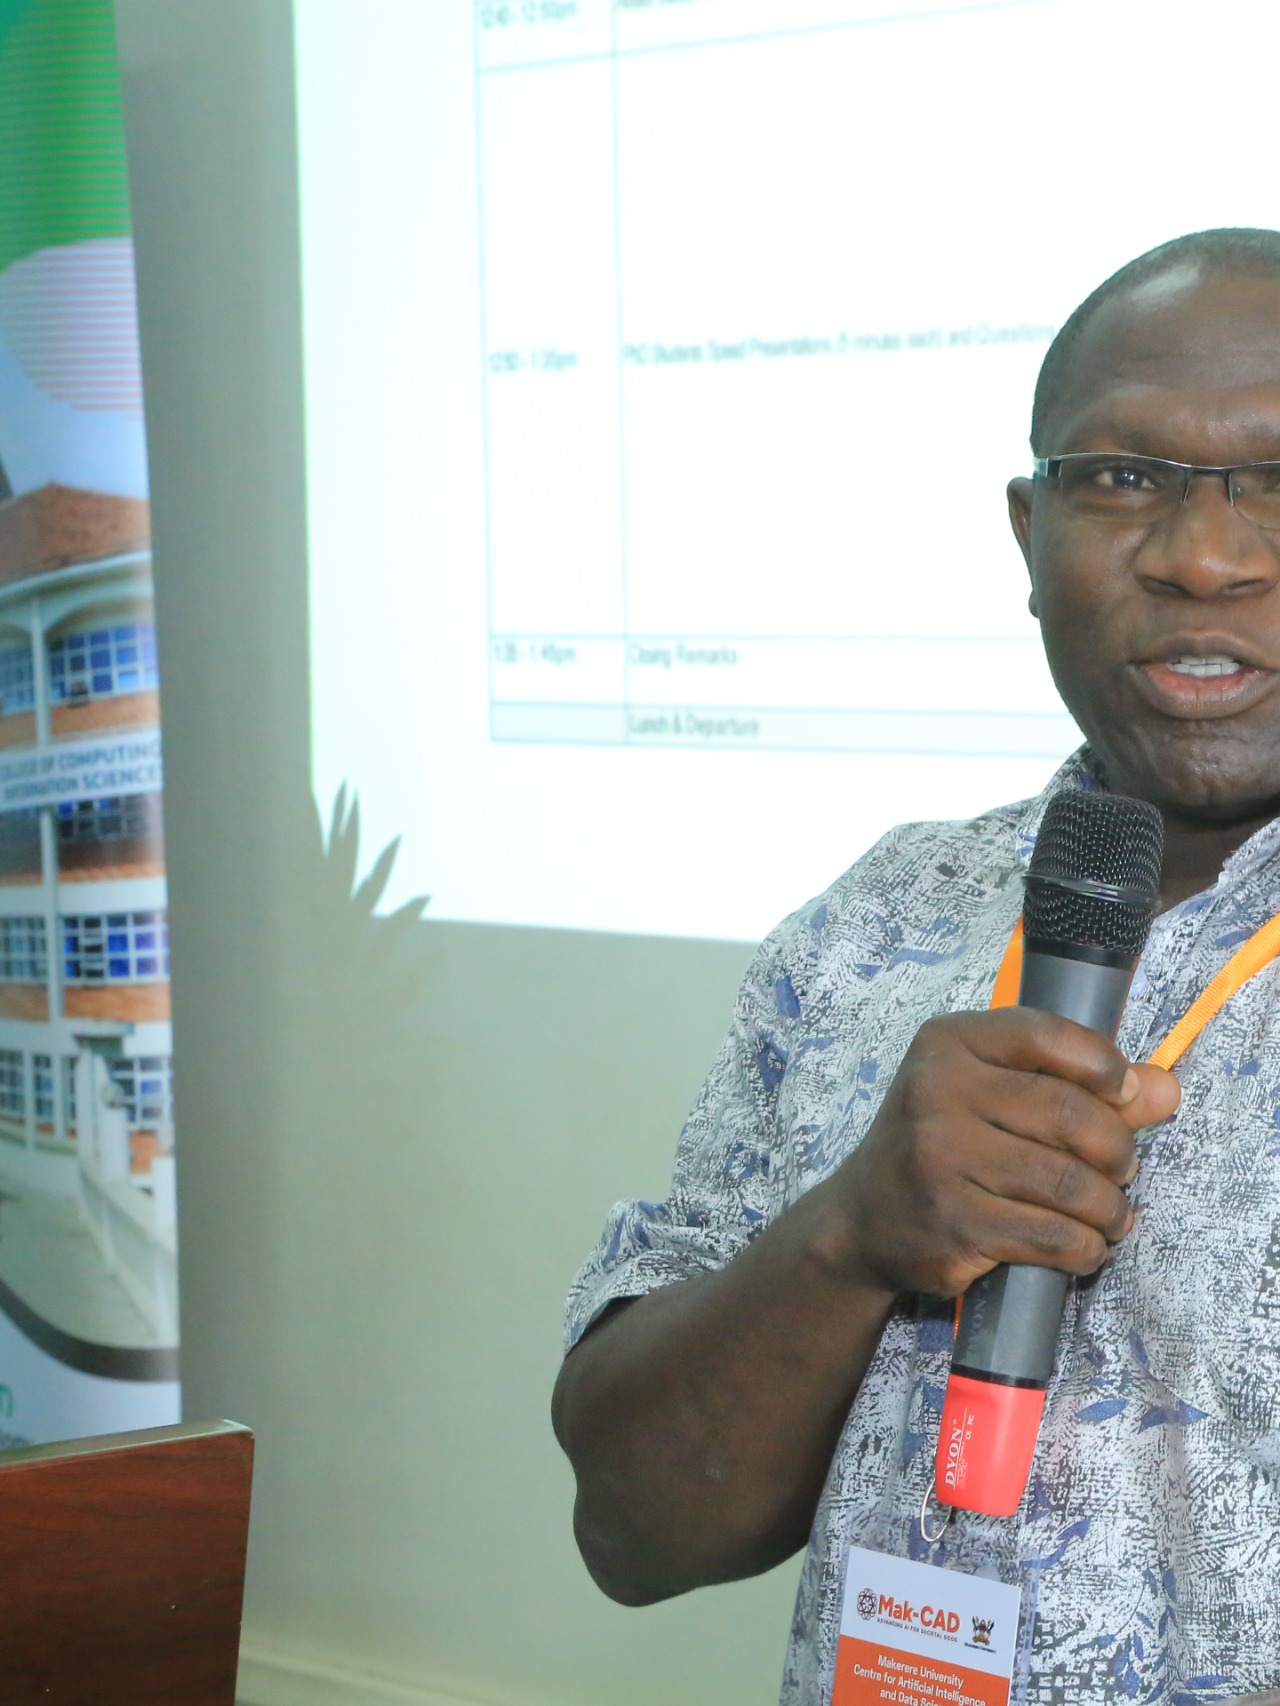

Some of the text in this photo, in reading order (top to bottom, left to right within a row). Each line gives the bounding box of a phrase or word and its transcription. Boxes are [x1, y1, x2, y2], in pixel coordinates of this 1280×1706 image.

[949, 325, 972, 347] and
[676, 643, 739, 666] Remarks
[628, 712, 760, 742] Lunch & Departure
[878, 1594, 960, 1634] Mak-CAD
[877, 1617, 903, 1629] ADVANCING
[921, 1628, 943, 1640] SOCIETAL
[853, 1663, 986, 1706] Centre for Artificial Intelligence
[878, 1654, 964, 1690] Makerere University
[880, 1688, 896, 1701] and
[898, 1691, 919, 1706] Data
